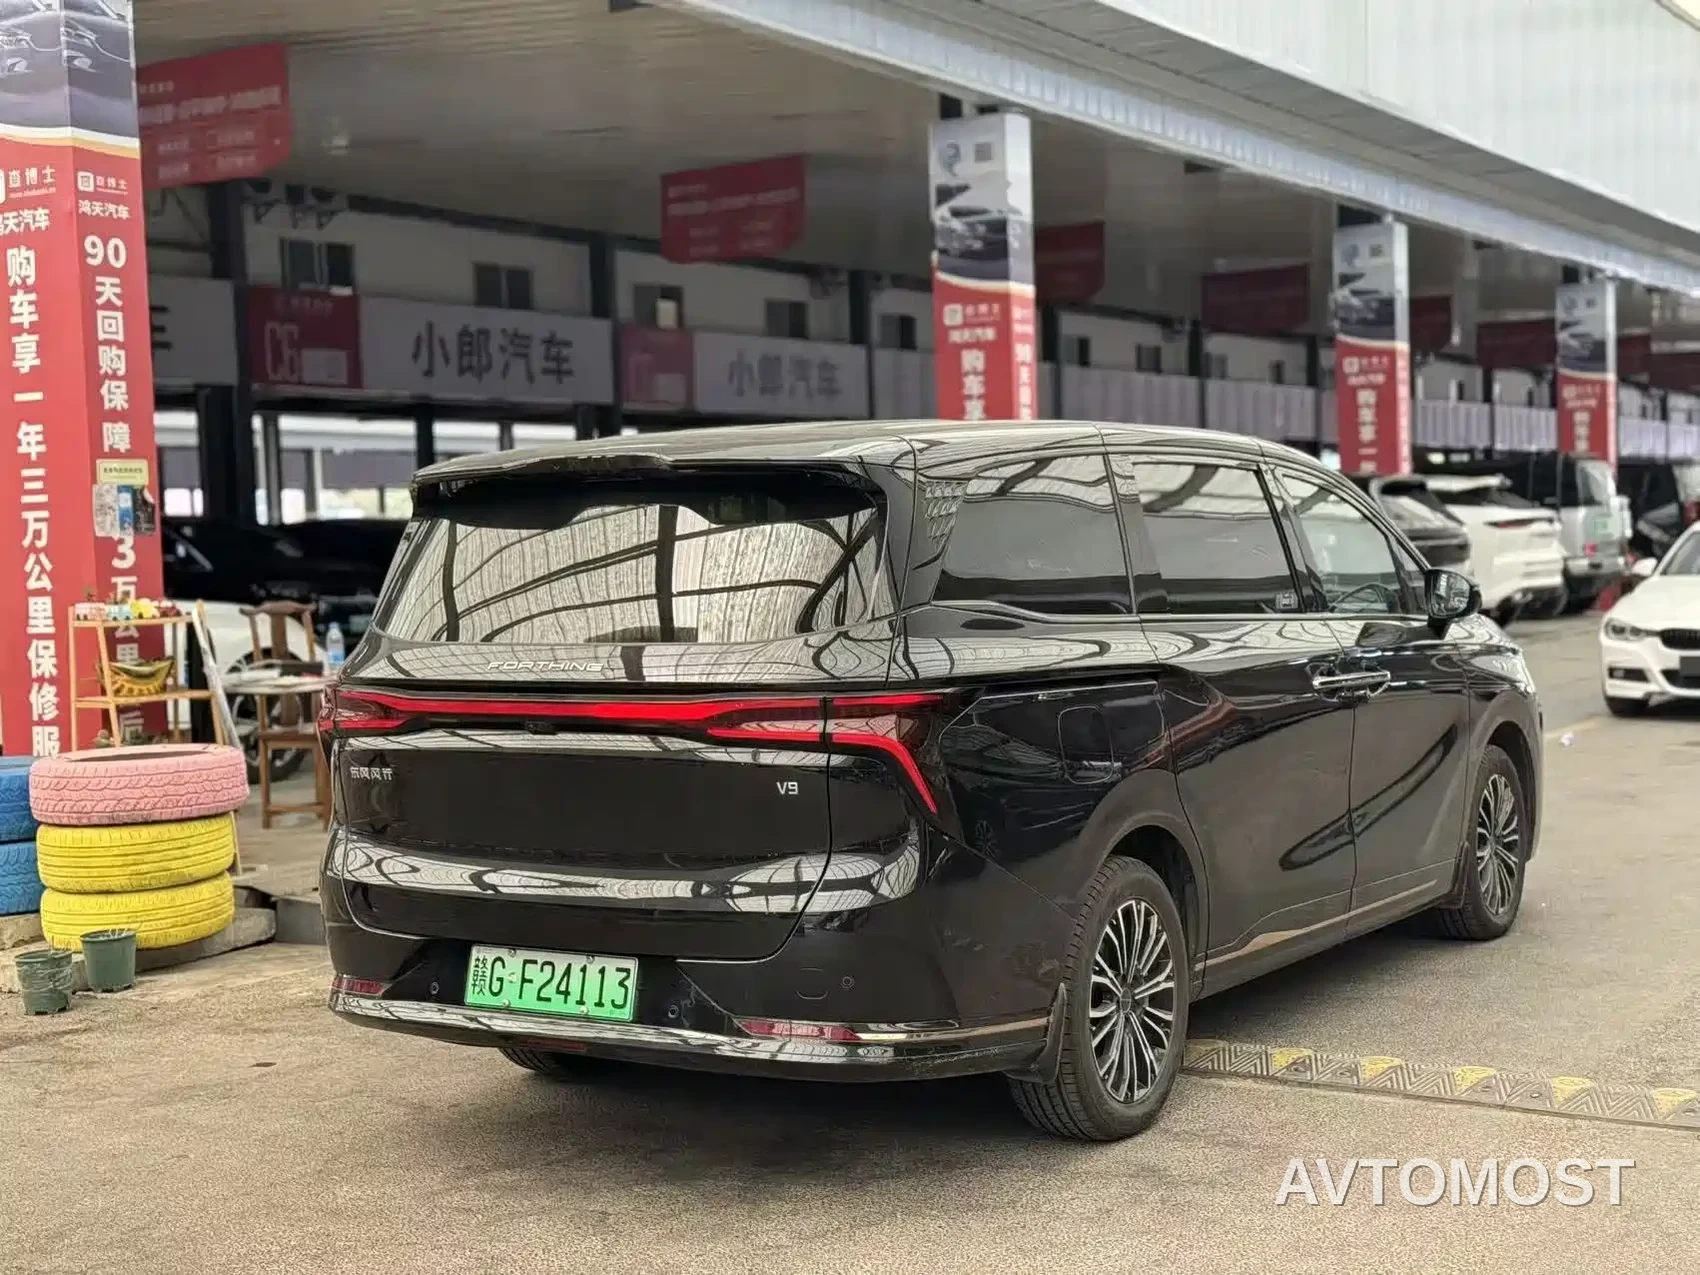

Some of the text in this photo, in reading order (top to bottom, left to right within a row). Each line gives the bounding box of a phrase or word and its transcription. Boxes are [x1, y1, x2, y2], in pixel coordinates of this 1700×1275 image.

[78, 199, 130, 221] 鸿天汽车
[411, 320, 574, 384] 小郎汽车
[487, 661, 604, 672] FORTHING
[350, 766, 393, 781] 东风风行
[776, 781, 799, 795] V9
